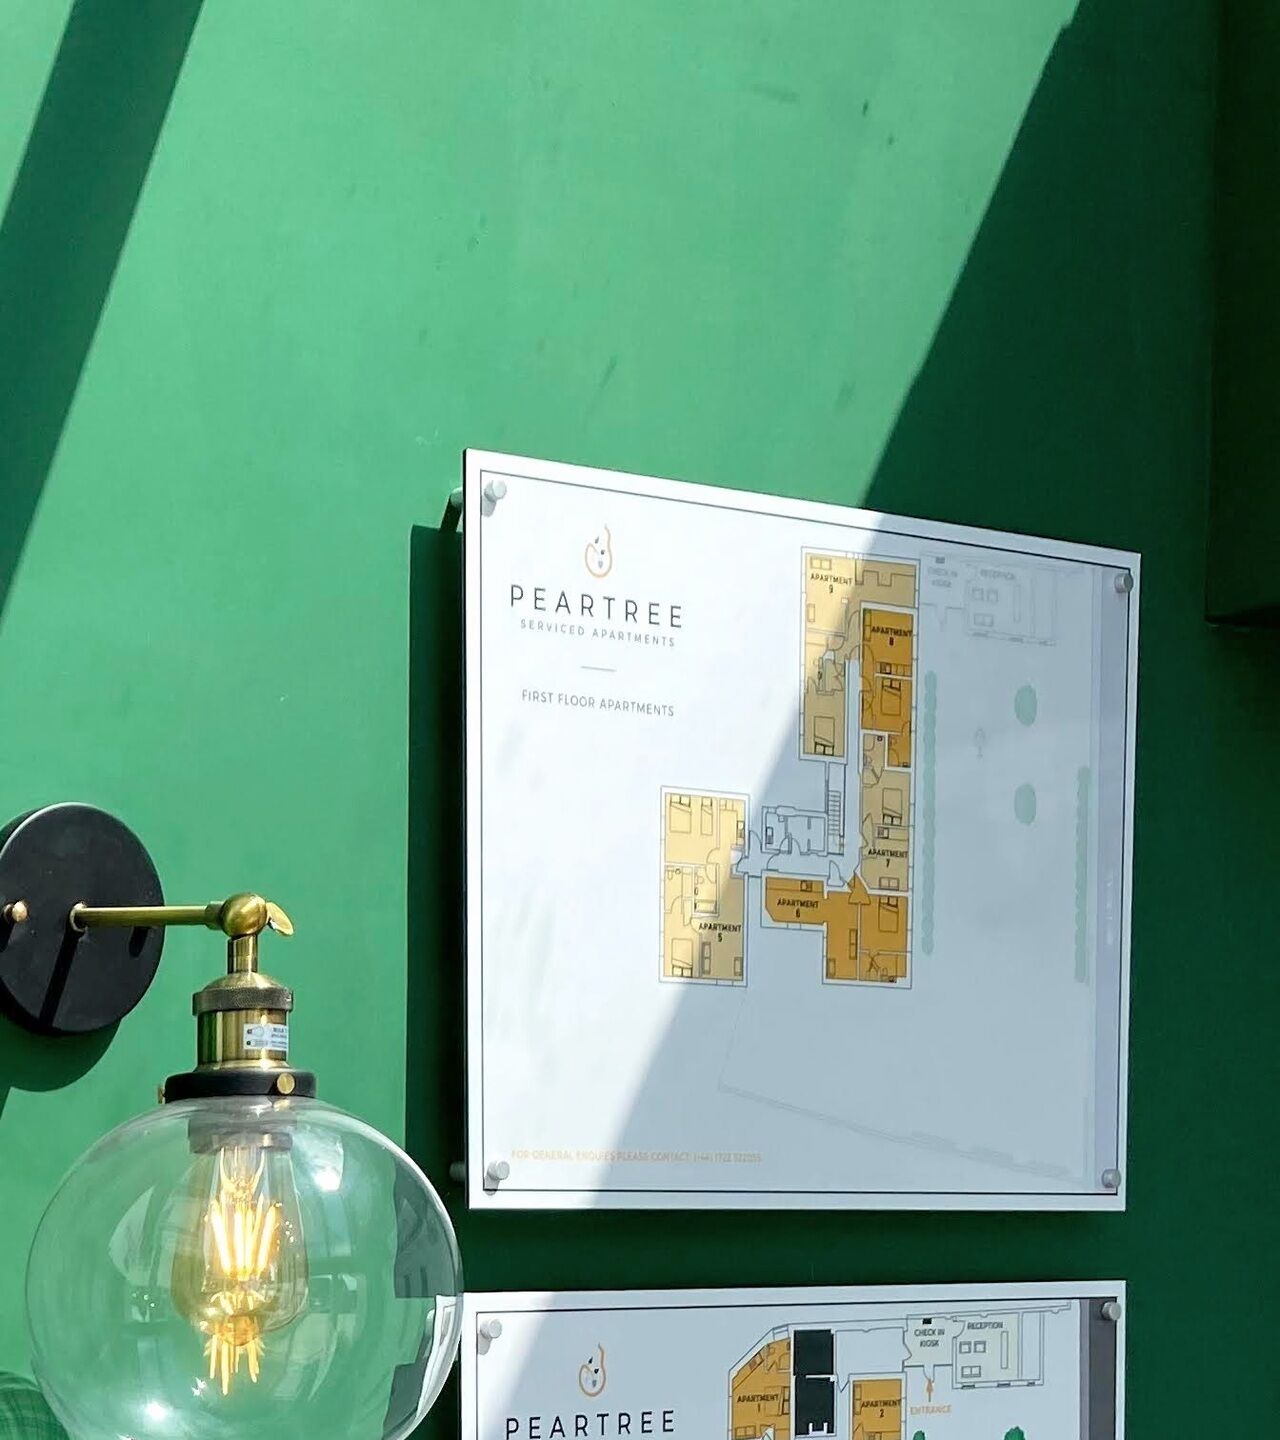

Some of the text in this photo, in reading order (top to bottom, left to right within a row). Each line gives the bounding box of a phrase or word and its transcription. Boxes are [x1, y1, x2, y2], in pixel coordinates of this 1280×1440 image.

[810, 573, 854, 585] APARTMENT
[510, 584, 682, 628] PEARTREE
[520, 618, 675, 647] SERVICED APARTMENTS
[871, 625, 913, 638] APARTMENT
[521, 689, 675, 717] FIRST FLOOR APARTMENTS
[868, 848, 908, 858] APARTMENT
[777, 899, 820, 909] APARTMENT
[698, 922, 742, 933] APARTMENT
[967, 1321, 1003, 1331] RECEPTION
[914, 1327, 945, 1338] CHECK IN
[920, 1339, 939, 1348] KIOSK
[737, 1393, 781, 1404] APARTMENT
[861, 1399, 901, 1410] APARTMENT
[878, 1409, 885, 1419] 2
[910, 1405, 952, 1416] ENTRANCE
[505, 1410, 675, 1440] PEARTREE
